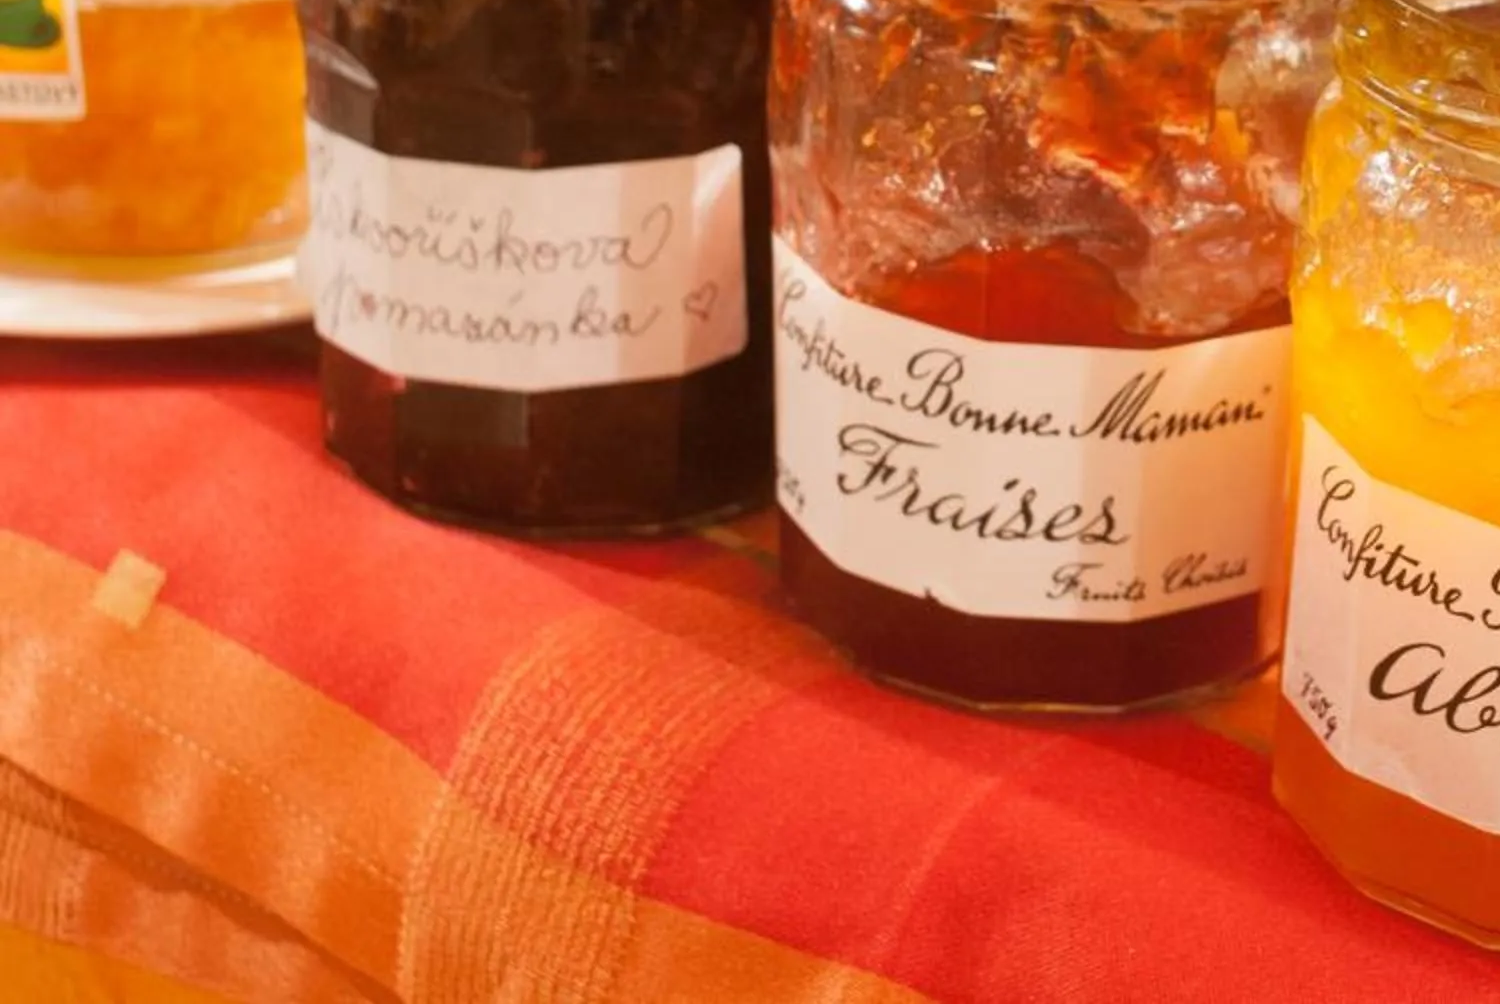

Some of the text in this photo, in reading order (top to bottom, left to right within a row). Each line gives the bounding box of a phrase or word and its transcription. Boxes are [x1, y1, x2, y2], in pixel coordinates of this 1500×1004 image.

[776, 277, 895, 406] Confiture
[900, 347, 1062, 437] Bonne
[836, 423, 1130, 545] Fraises
[1317, 464, 1476, 623] Confiture
[1045, 561, 1147, 601] Fruits
